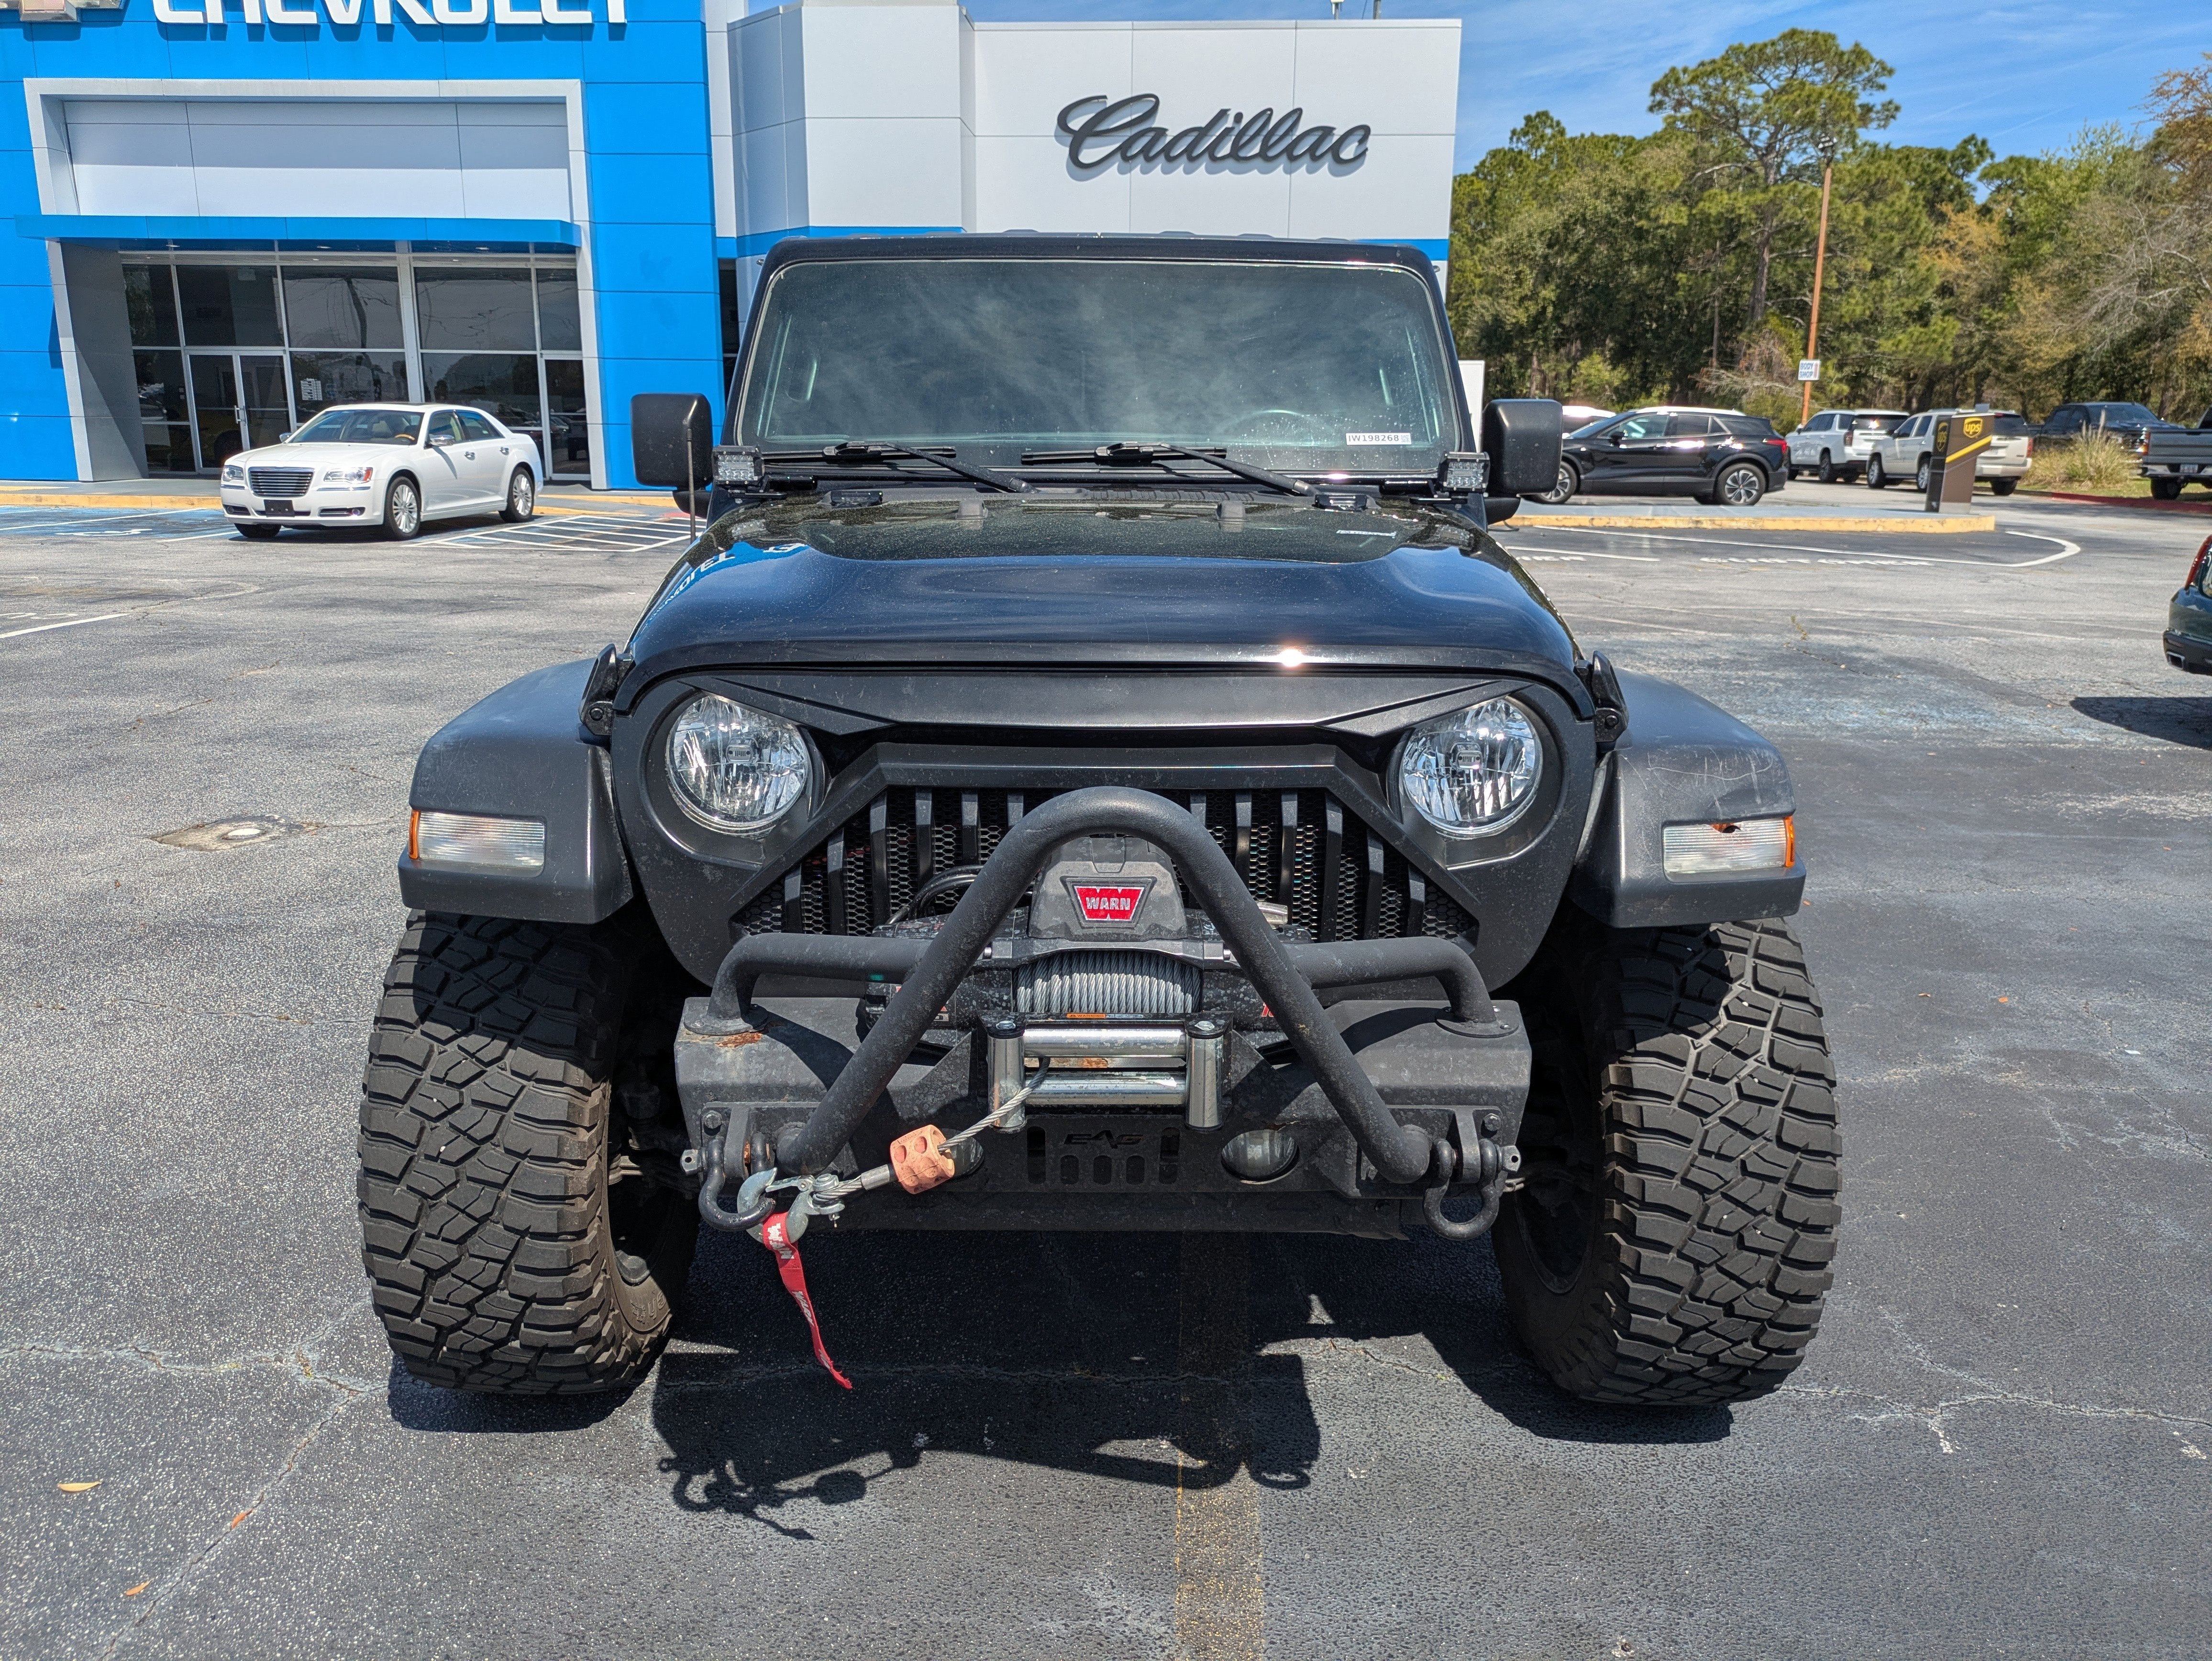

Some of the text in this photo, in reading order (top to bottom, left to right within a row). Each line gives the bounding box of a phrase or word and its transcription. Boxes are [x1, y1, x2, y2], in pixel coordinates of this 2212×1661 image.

[1057, 93, 1371, 169] Cadillac
[1965, 424, 1981, 434] ups
[1086, 897, 1130, 910] WARN
[792, 1291, 814, 1327] WARN
